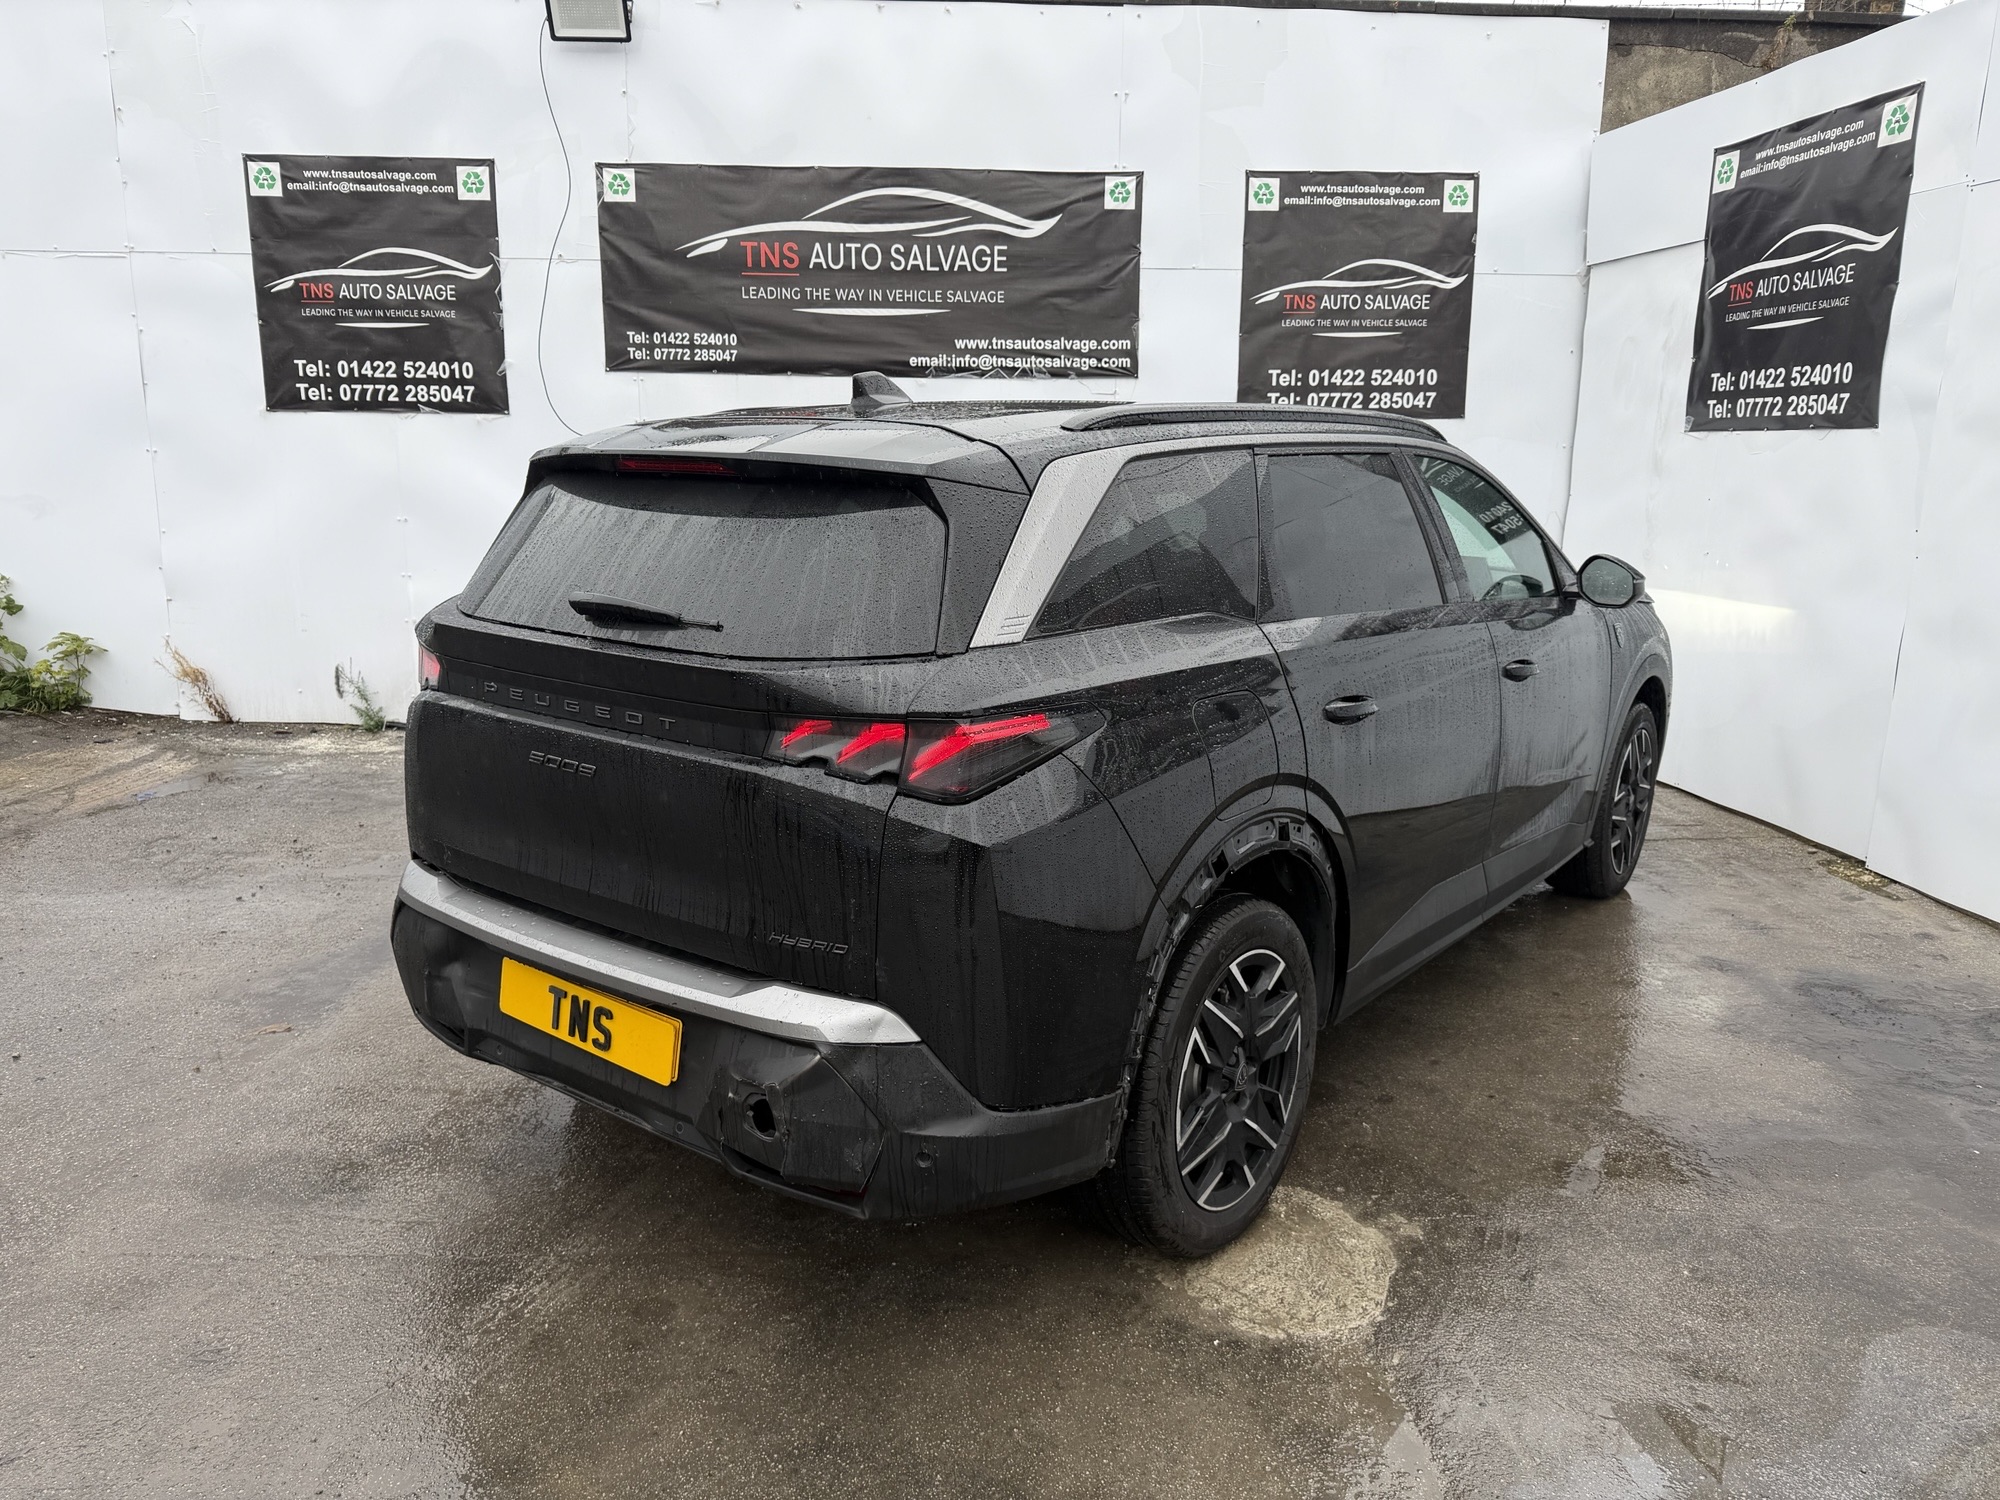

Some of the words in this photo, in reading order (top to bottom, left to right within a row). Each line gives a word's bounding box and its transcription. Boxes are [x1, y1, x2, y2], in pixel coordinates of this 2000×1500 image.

[1755, 119, 1864, 160] www.tnsautosalvage.com
[1740, 130, 1876, 179] email:info@tnsautosalvage.com
[303, 169, 437, 182] www.tnsautosalvage.com
[287, 181, 454, 194] email:info@tnsautosalvage.com
[1300, 185, 1425, 196] www.tnsautosalvage.com
[1284, 196, 1440, 207] email:info@tnsautosalvage.com
[740, 241, 800, 269] TNS
[809, 242, 882, 271] AUTO
[890, 243, 1008, 272] SALVAGE
[1729, 280, 1754, 300] TNS
[1755, 274, 1790, 297] AUTO
[1793, 263, 1856, 291] SALVAGE
[299, 282, 334, 298] TNS
[339, 283, 382, 300] AUTO
[386, 283, 456, 301] SALVAGE
[741, 286, 801, 299] LEADING
[805, 288, 830, 300] THE
[835, 288, 865, 301] WAY
[869, 289, 882, 301] IN
[887, 289, 942, 302] VEHICLE
[947, 290, 1005, 303] SALVAGE
[1284, 294, 1316, 310] TNS
[1320, 294, 1361, 310] AUTO
[1364, 294, 1431, 310] SALVAGE
[1726, 311, 1750, 322] LEADING
[1751, 309, 1763, 319] THE
[1764, 306, 1778, 316] WAY
[1779, 305, 1786, 314] IN
[1787, 300, 1817, 313] VEHICLE
[1819, 296, 1850, 310] SALVAGE
[301, 309, 335, 317] LEADING
[338, 309, 353, 317] THE
[356, 309, 372, 317] WAY
[375, 309, 384, 317] IN
[386, 309, 418, 317] VEHICLE
[421, 310, 456, 318] SALVAGE
[1362, 319, 1393, 327] VEHICLE
[1395, 319, 1427, 327] SALVAGE
[626, 331, 650, 344] Tel:
[653, 332, 690, 345] 01422
[694, 333, 737, 346] 524010
[955, 337, 1131, 351] www.tnsautosalvage.com
[627, 347, 650, 360] Tel:
[654, 348, 690, 361] 07772
[694, 348, 737, 361] 285047
[909, 354, 1131, 370] email:info@tnsautosalvage.com
[294, 360, 330, 377] Tel:
[337, 360, 397, 378] 01422
[403, 361, 473, 379] 524010
[1268, 369, 1302, 386] Tel:
[1308, 370, 1365, 386] 01422
[1371, 369, 1437, 386] 524010
[1710, 371, 1735, 392] Tel:
[1739, 367, 1784, 390] 01422
[1790, 361, 1853, 386] 524010
[296, 383, 332, 401] Tel:
[339, 384, 399, 402] 07772
[405, 384, 474, 402] 285047
[1267, 393, 1301, 405] Tel:
[1307, 393, 1362, 408] 07772
[1369, 392, 1437, 409] 285047
[1707, 398, 1732, 419] Tel:
[1736, 395, 1782, 417] 07772
[1787, 392, 1850, 416] 285047
[484, 682, 676, 730] PEUGEOT
[529, 750, 597, 778] 5008
[768, 932, 848, 954] HYBRID
[548, 985, 614, 1052] TNS
